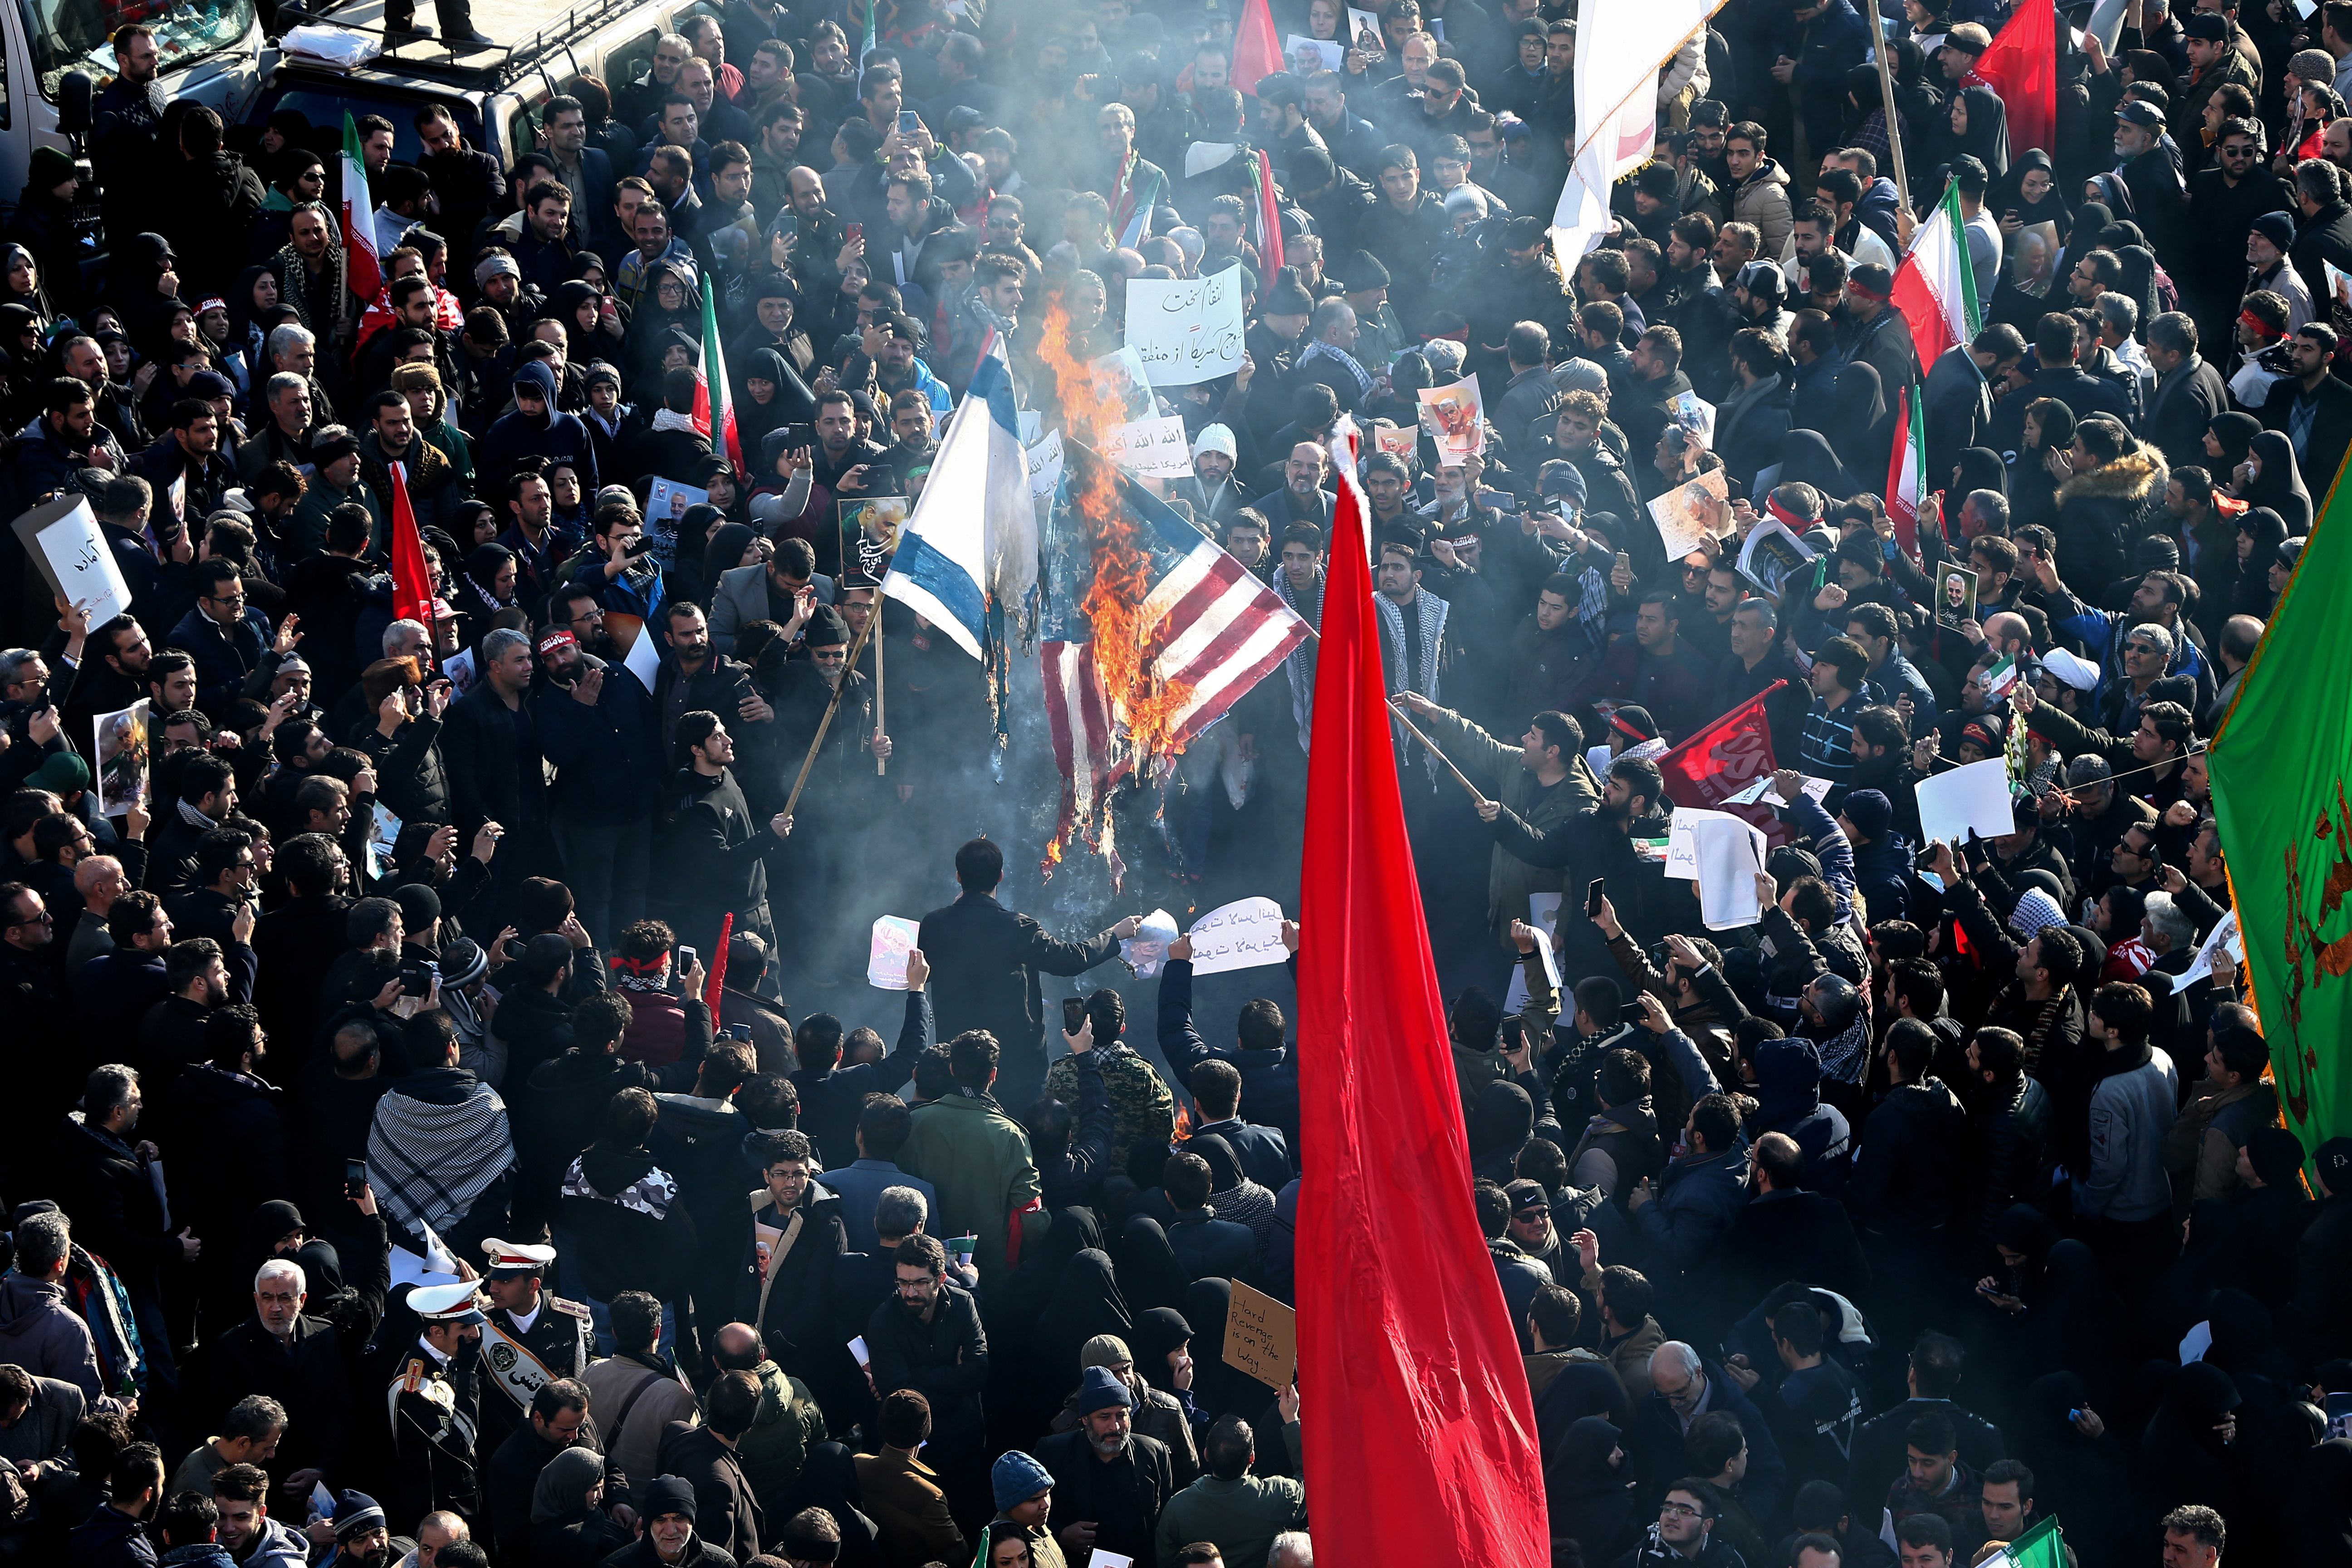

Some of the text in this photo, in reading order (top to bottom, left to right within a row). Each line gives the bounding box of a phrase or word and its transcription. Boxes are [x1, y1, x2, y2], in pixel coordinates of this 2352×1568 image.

[1162, 274, 1224, 314] انتقام سخت
[1141, 338, 1168, 363] منطق
[1171, 341, 1184, 365] از
[1220, 328, 1242, 360] خروج
[1135, 429, 1154, 449] الله
[1162, 426, 1181, 444] الله
[1029, 441, 1061, 475] الله الله
[74, 533, 102, 571] آماده
[1684, 760, 1714, 798] HARD
[1233, 1295, 1265, 1323] Hard
[1231, 1311, 1273, 1343] Revenge
[1233, 1328, 1279, 1360] is on the
[508, 1372, 544, 1393] تش
